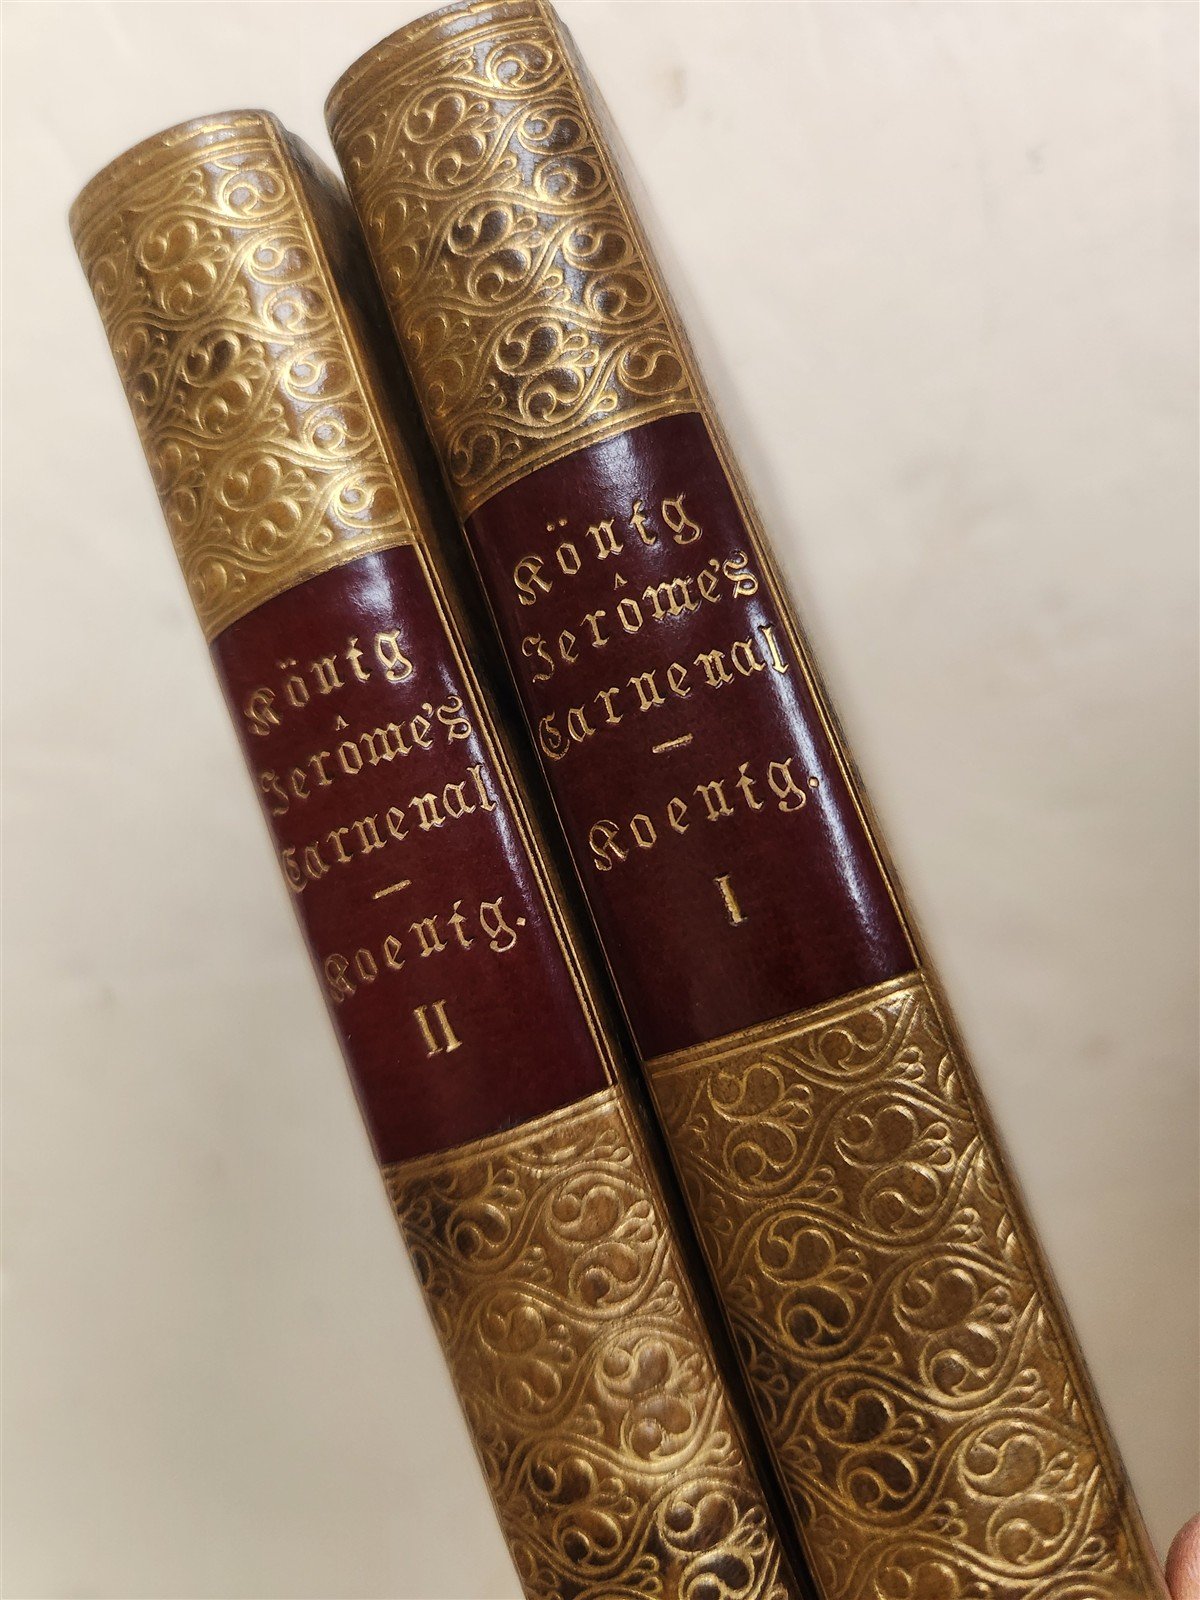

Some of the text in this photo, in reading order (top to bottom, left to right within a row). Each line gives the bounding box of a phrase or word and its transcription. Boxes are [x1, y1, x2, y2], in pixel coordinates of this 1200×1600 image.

[513, 493, 702, 606] König
[247, 629, 415, 736] König
[714, 873, 747, 926] I
[413, 1000, 462, 1057] II
